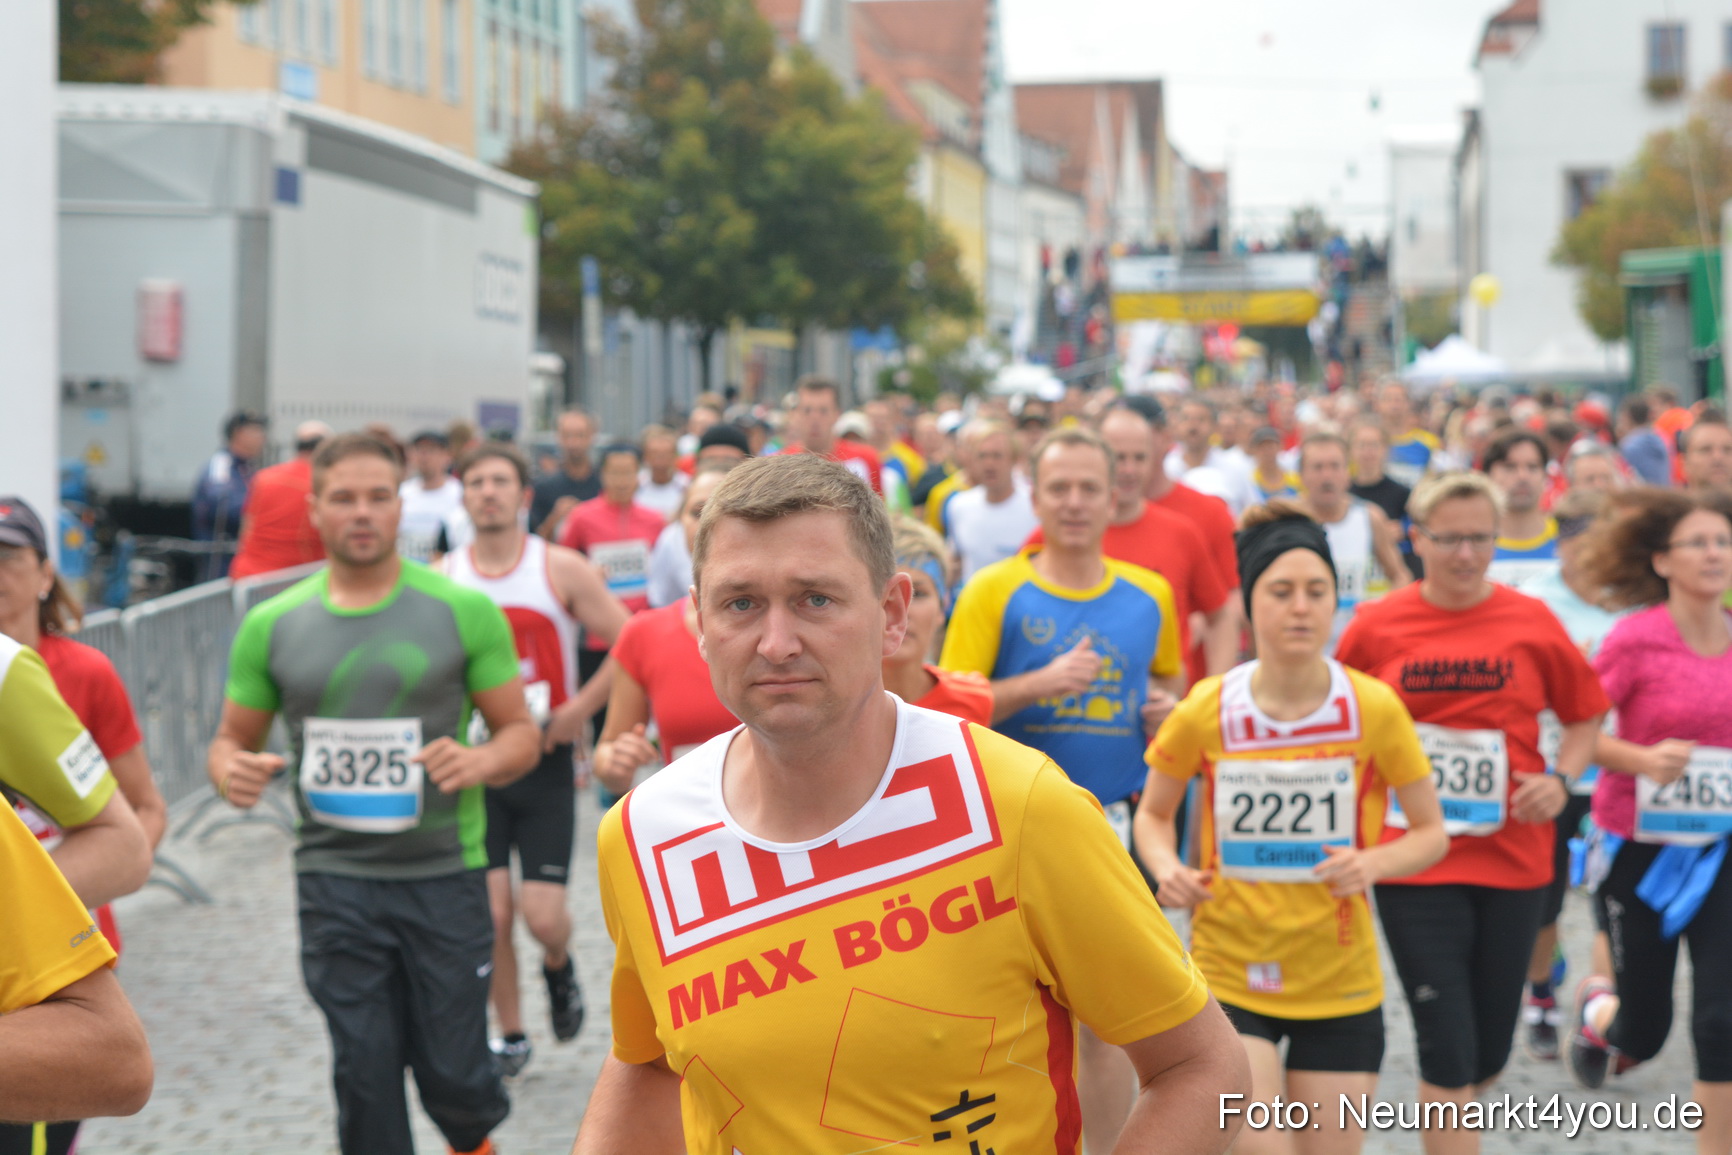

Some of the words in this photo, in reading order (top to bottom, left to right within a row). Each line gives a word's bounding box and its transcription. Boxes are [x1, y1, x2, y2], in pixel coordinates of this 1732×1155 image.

[313, 747, 408, 786] 3325
[1232, 790, 1336, 834] 2221
[667, 938, 818, 1030] MAX
[833, 875, 1018, 970] BÖGL
